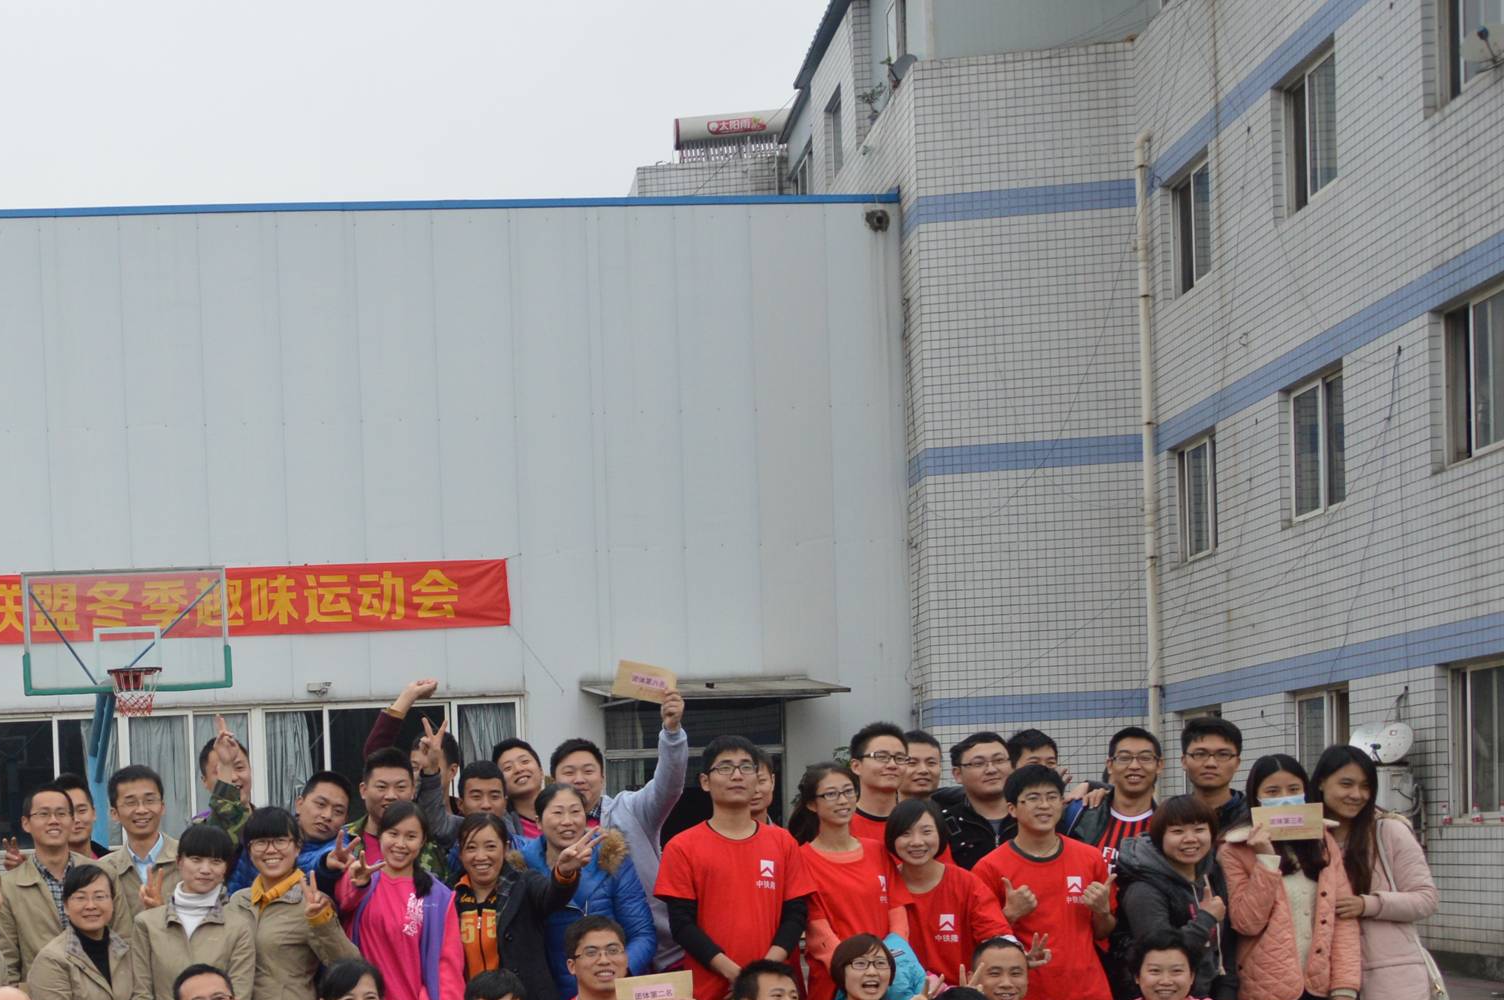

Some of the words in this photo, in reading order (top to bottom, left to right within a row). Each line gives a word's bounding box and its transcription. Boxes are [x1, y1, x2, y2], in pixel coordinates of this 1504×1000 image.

[635, 989, 673, 1000] 团体第二名
